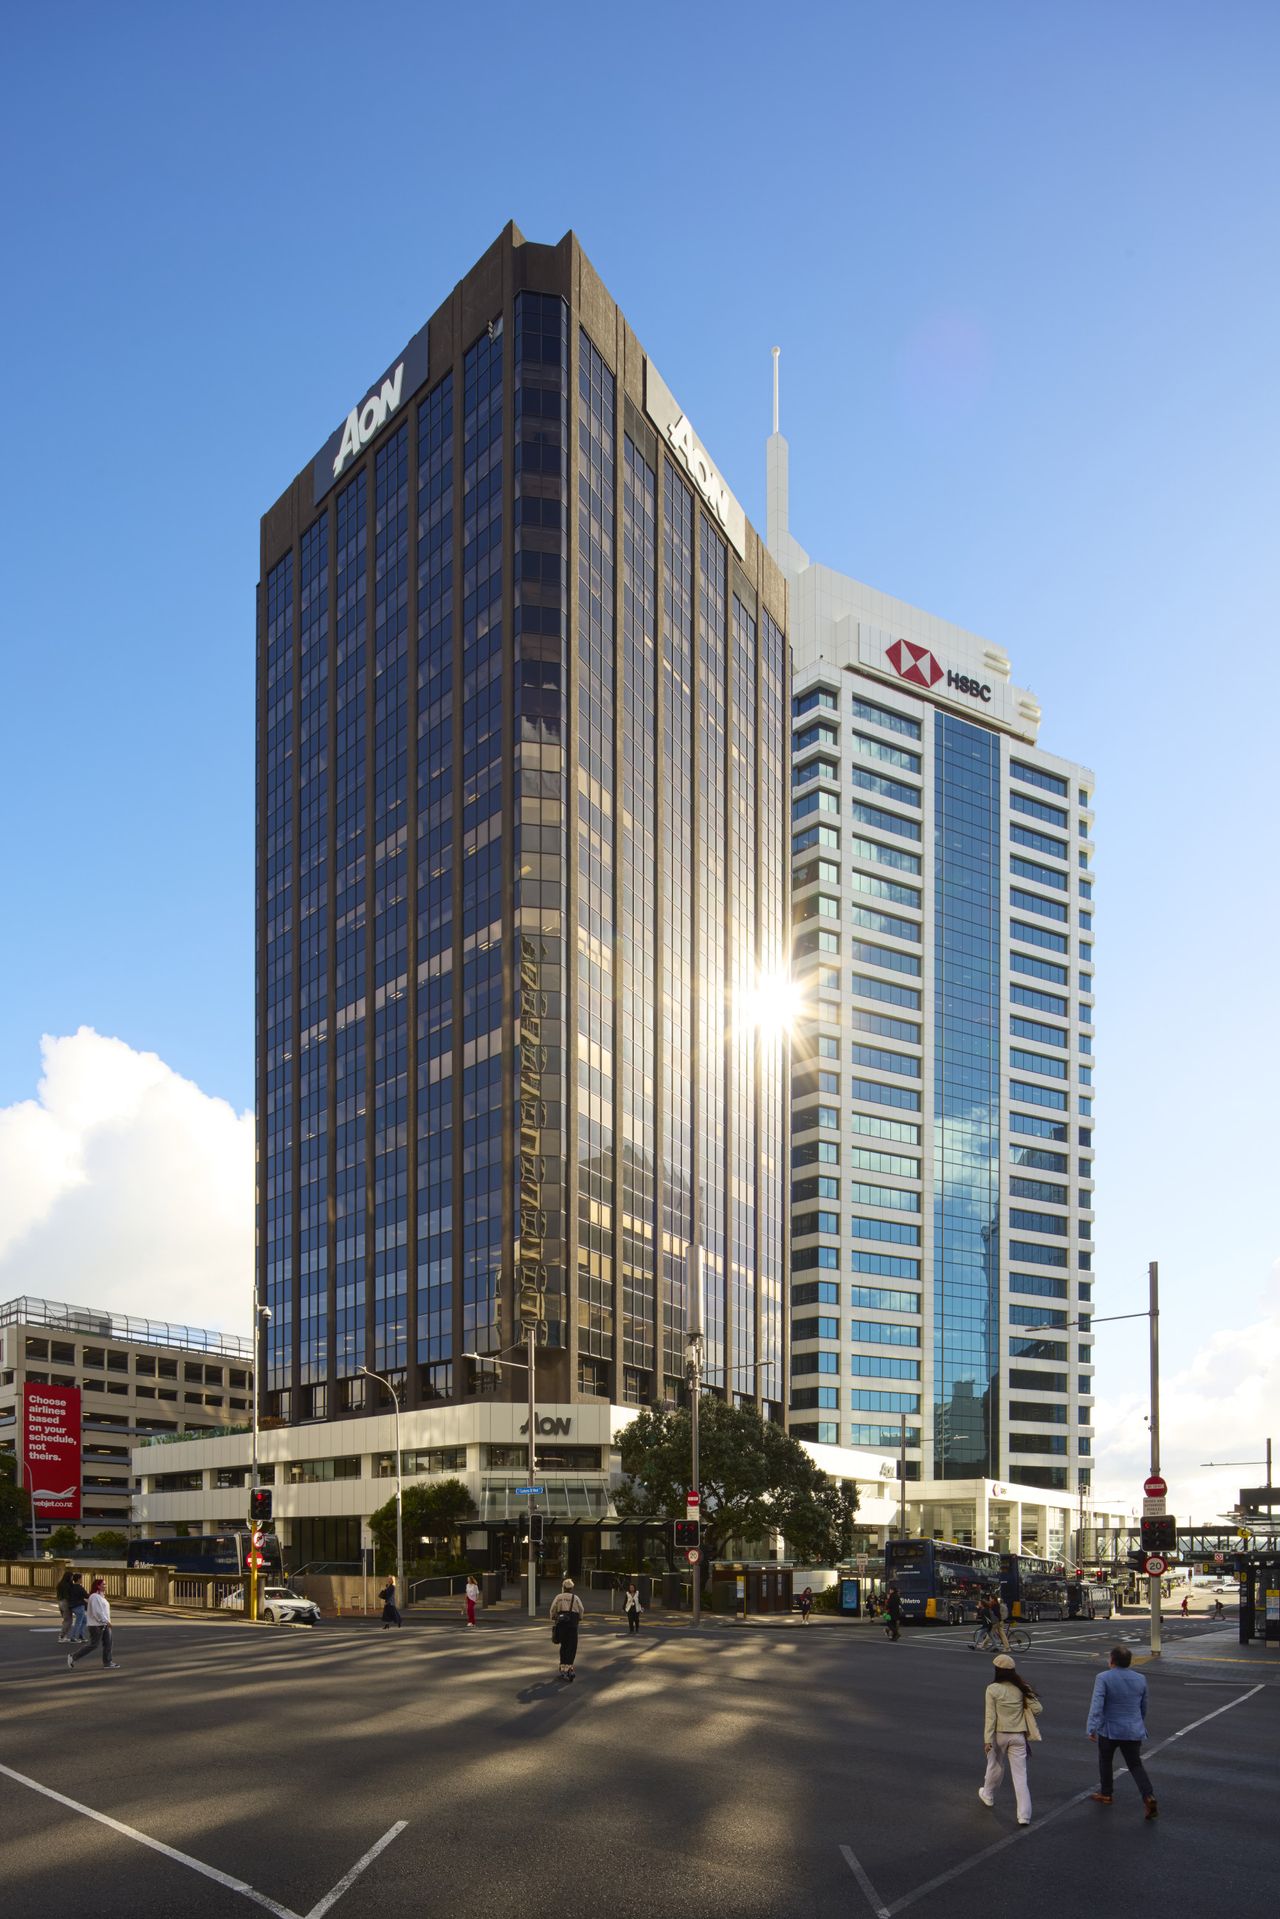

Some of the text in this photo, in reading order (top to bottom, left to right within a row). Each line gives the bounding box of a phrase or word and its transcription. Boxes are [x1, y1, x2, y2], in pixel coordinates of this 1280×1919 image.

[947, 669, 991, 703] HSBC
[29, 1395, 67, 1406] Choose
[29, 1405, 66, 1416] airlines
[29, 1414, 59, 1424] based
[29, 1424, 67, 1434] on your
[29, 1433, 77, 1446] schedule,
[29, 1442, 47, 1451] not
[29, 1451, 62, 1462] theirs.
[1149, 1562, 1162, 1570] 20
